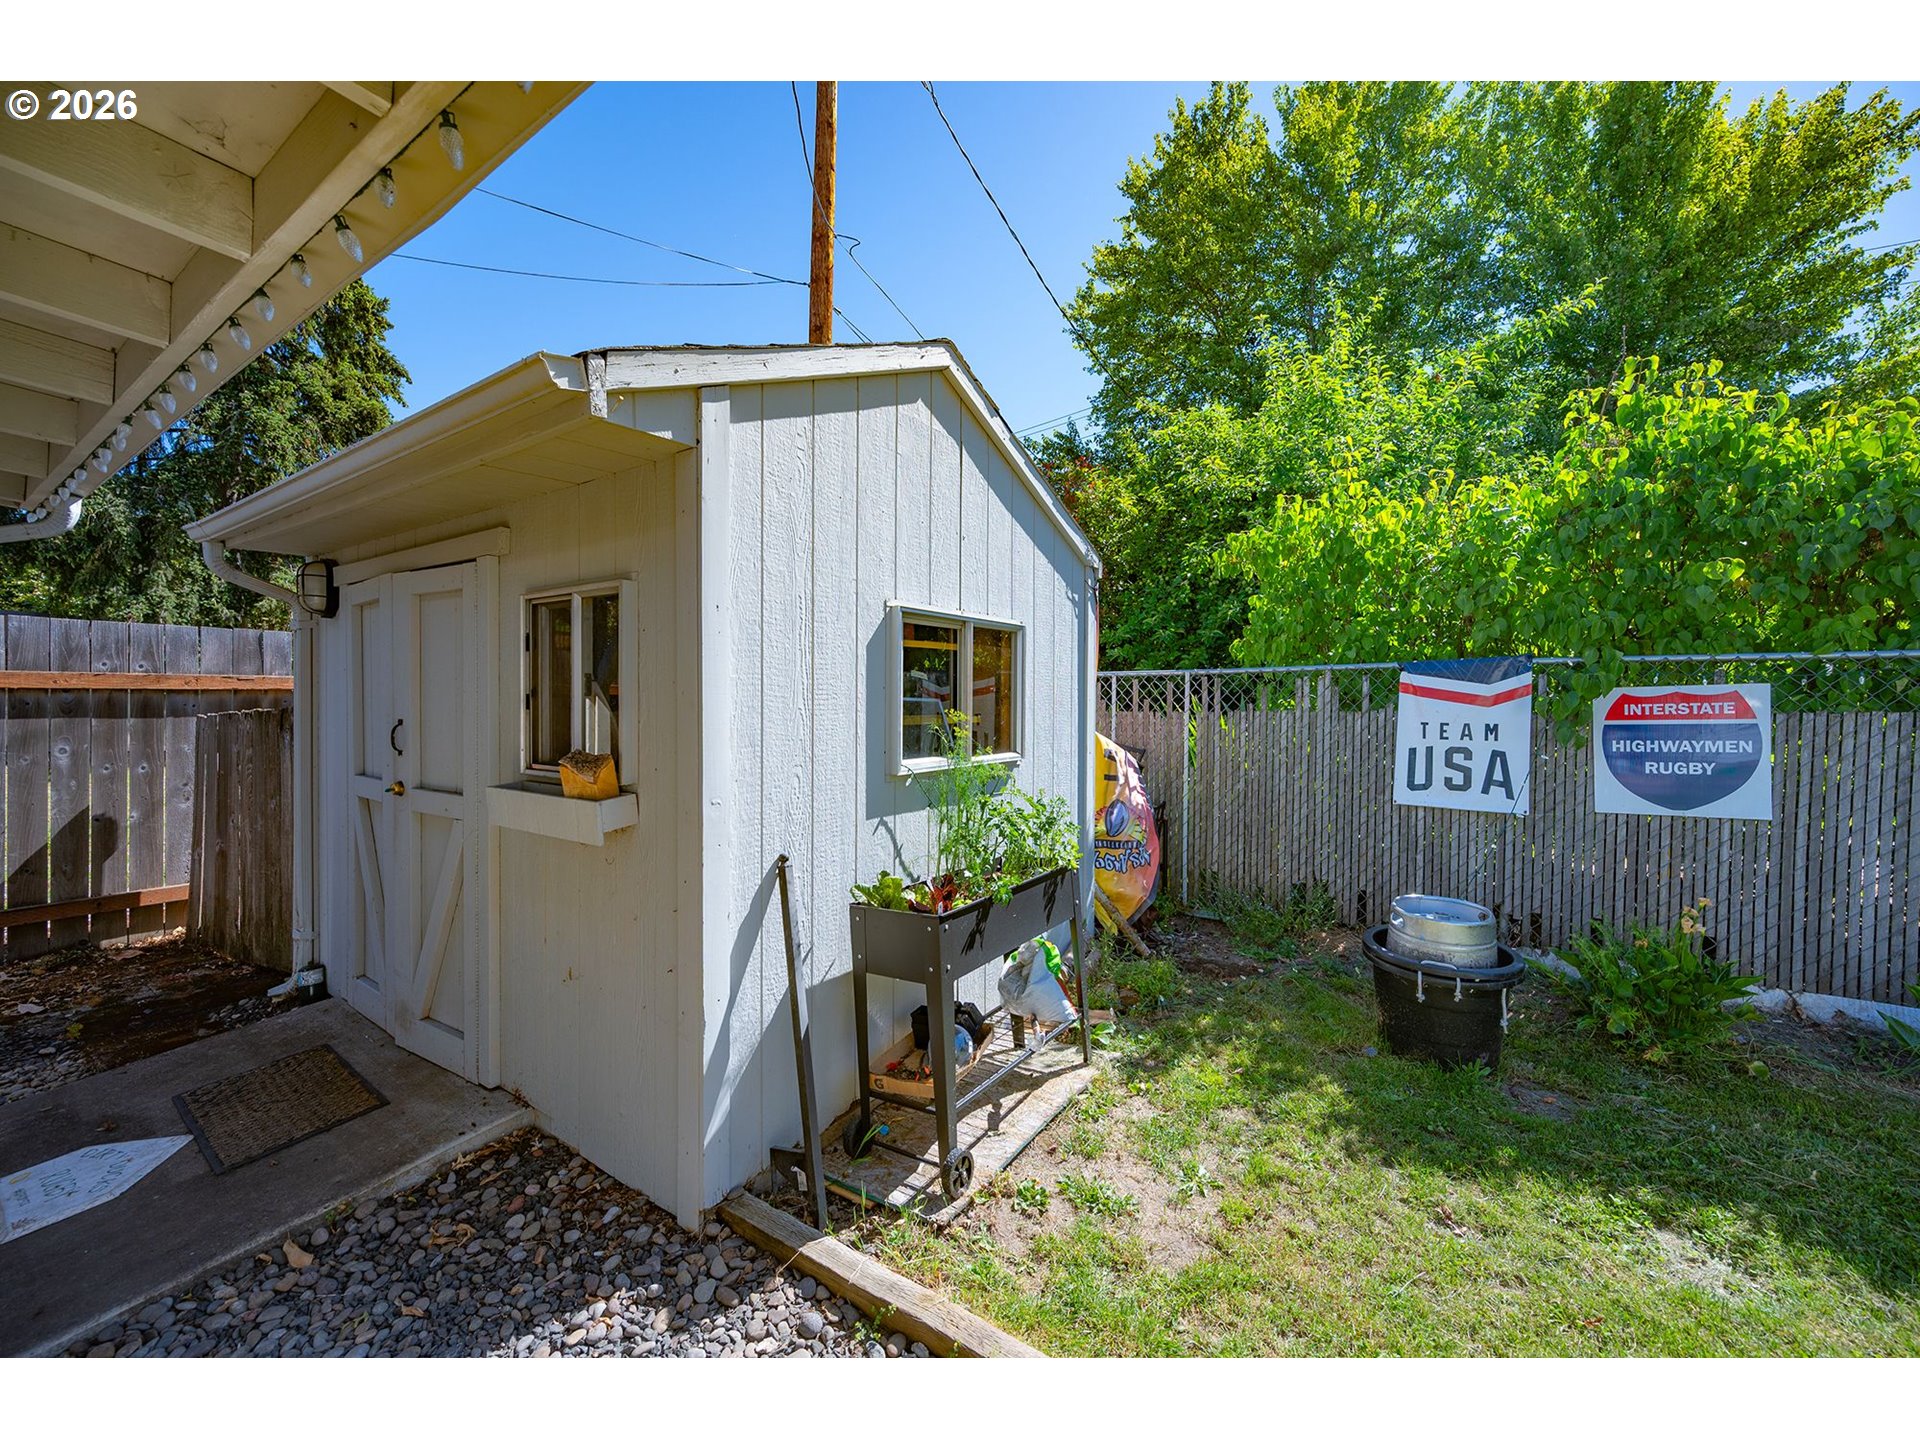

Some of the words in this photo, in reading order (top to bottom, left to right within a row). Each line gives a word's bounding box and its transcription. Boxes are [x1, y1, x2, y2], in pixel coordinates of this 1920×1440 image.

[1623, 702, 1736, 716] INTERSTATE
[1420, 721, 1499, 742] TEAM
[1612, 740, 1753, 754] HIGHWAYMEN
[1406, 745, 1516, 801] USA
[1645, 762, 1716, 776] RUGBY
